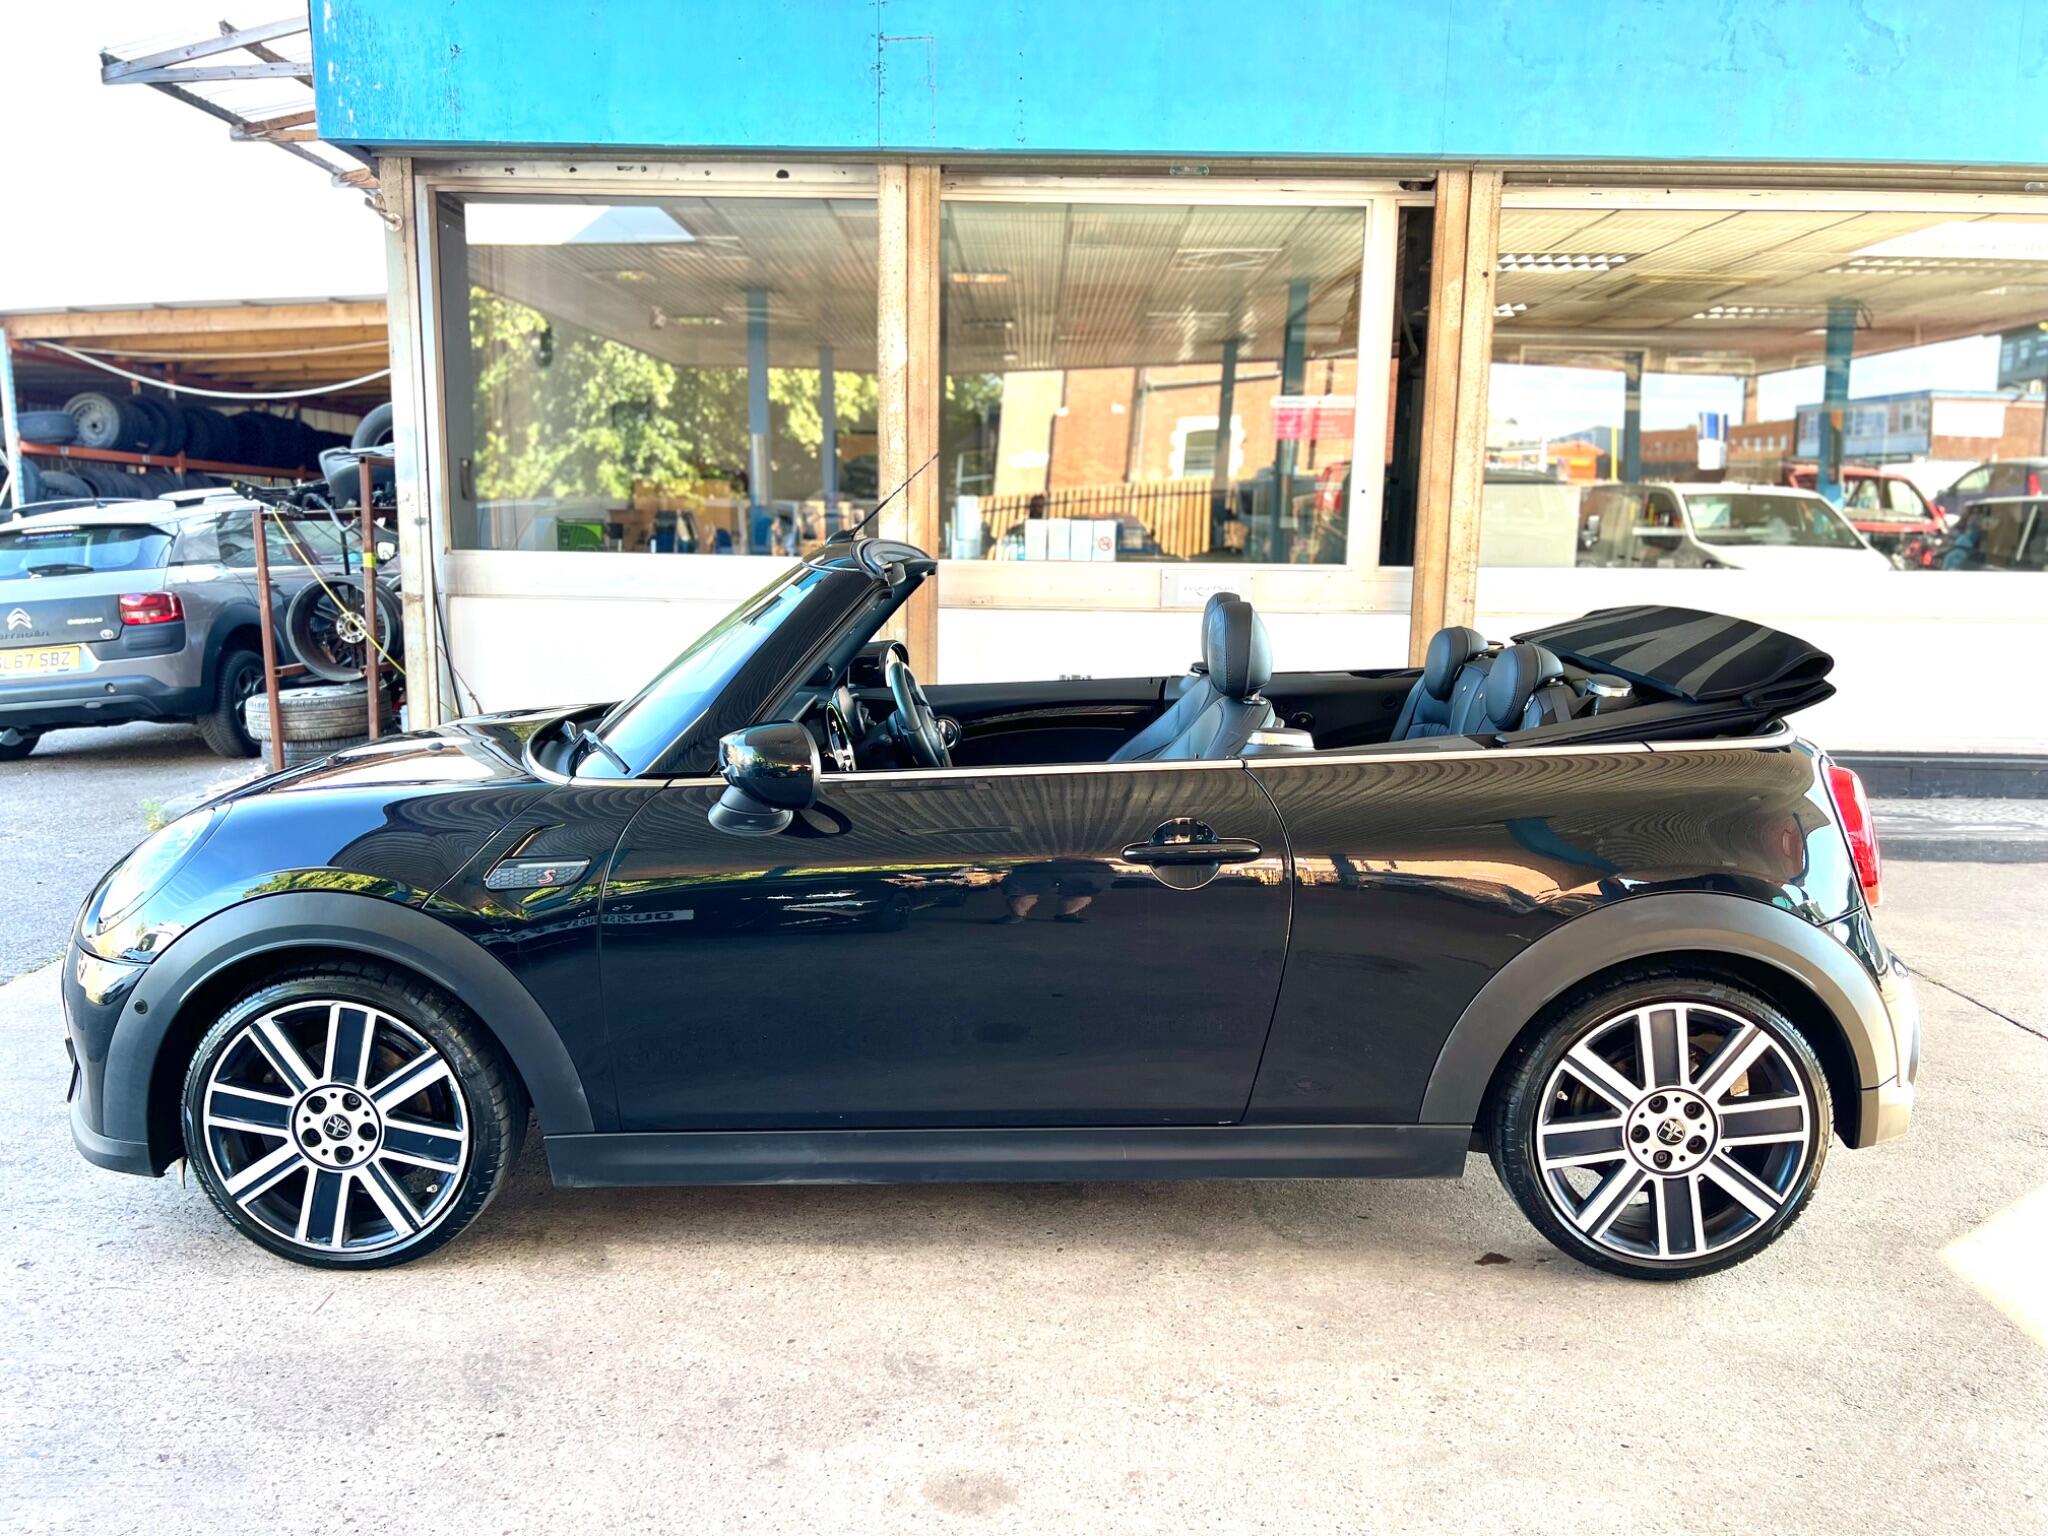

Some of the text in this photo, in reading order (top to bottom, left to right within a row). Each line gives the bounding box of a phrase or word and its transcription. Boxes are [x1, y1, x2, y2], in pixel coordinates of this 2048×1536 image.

[0, 651, 70, 670] L67 SBZ
[538, 869, 556, 884] S
